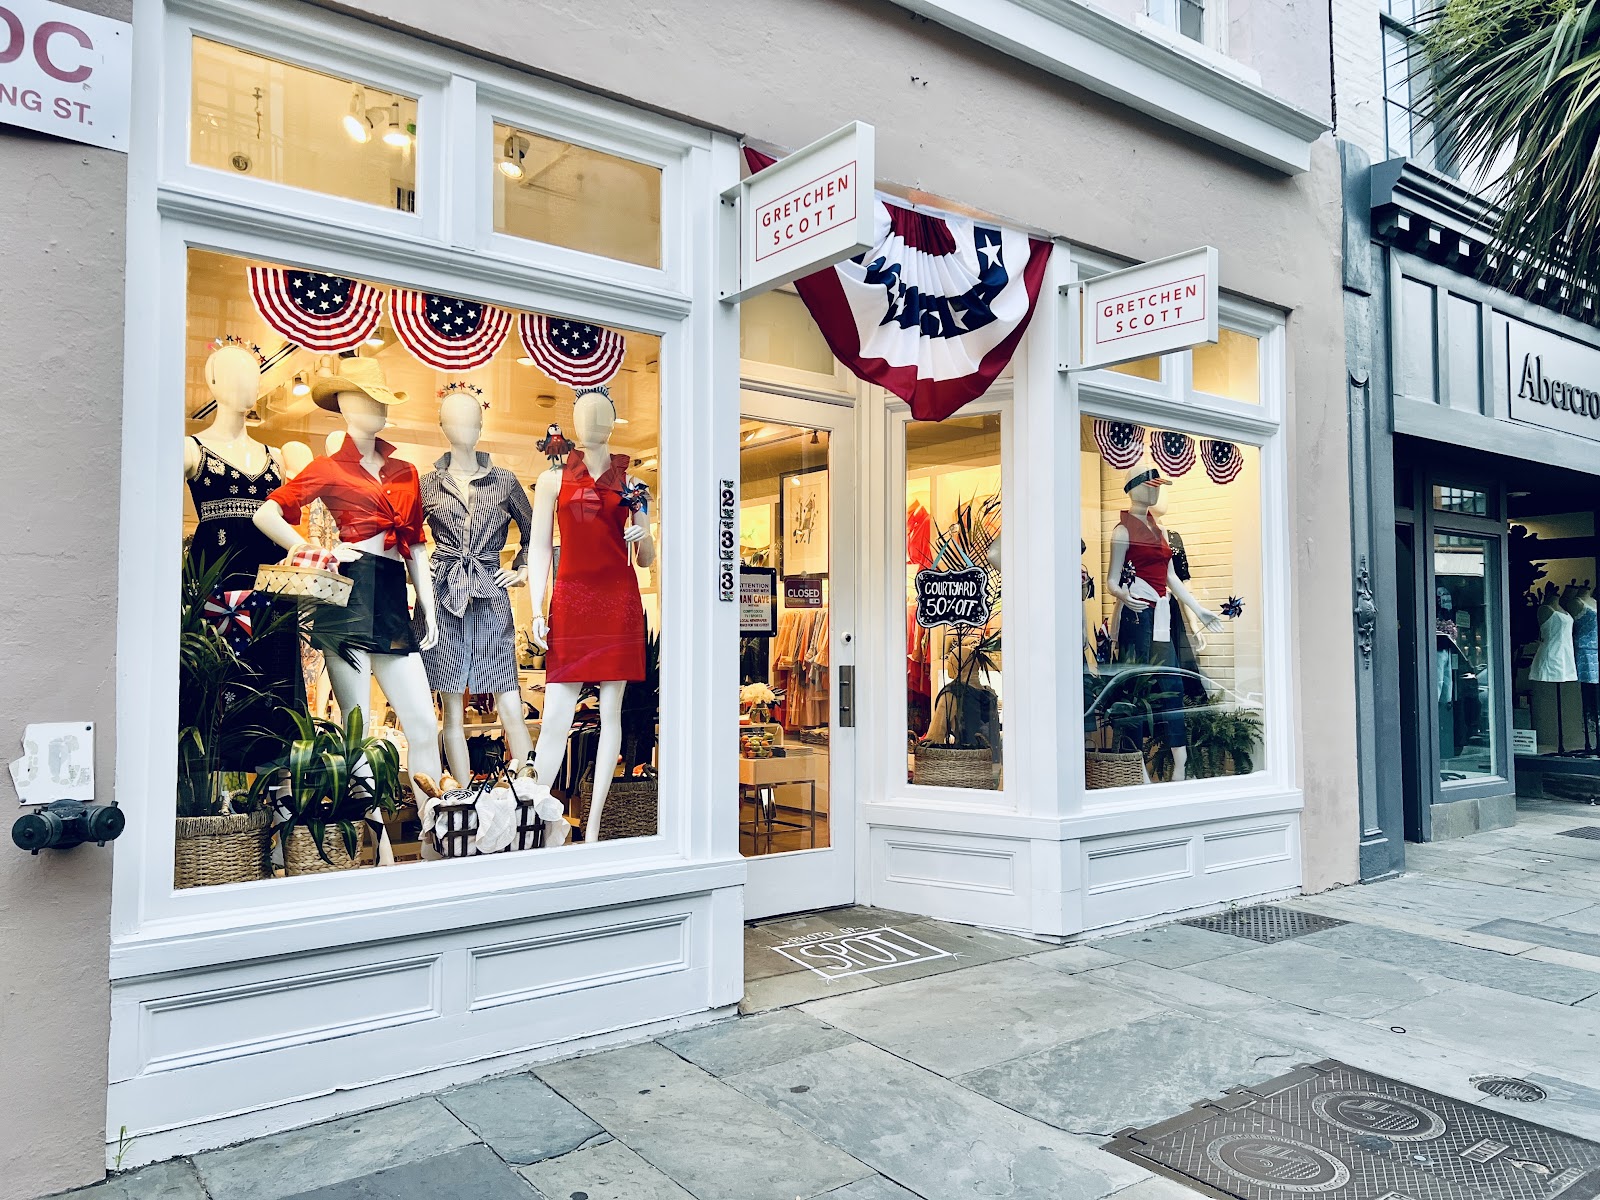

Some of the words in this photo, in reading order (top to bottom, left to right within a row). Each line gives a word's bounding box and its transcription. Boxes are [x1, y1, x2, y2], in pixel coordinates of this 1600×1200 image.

[53, 97, 93, 125] ST.
[762, 174, 849, 227] GRETCHEN
[774, 204, 836, 245] SCOTT
[1104, 284, 1196, 318] GRETCHEN
[1116, 306, 1183, 333] SCOTT
[1517, 352, 1600, 420] Abercro
[753, 594, 770, 604] CAVE
[787, 588, 820, 598] CLOSED
[925, 581, 977, 597] COURTYARD
[800, 933, 920, 970] SPOT
